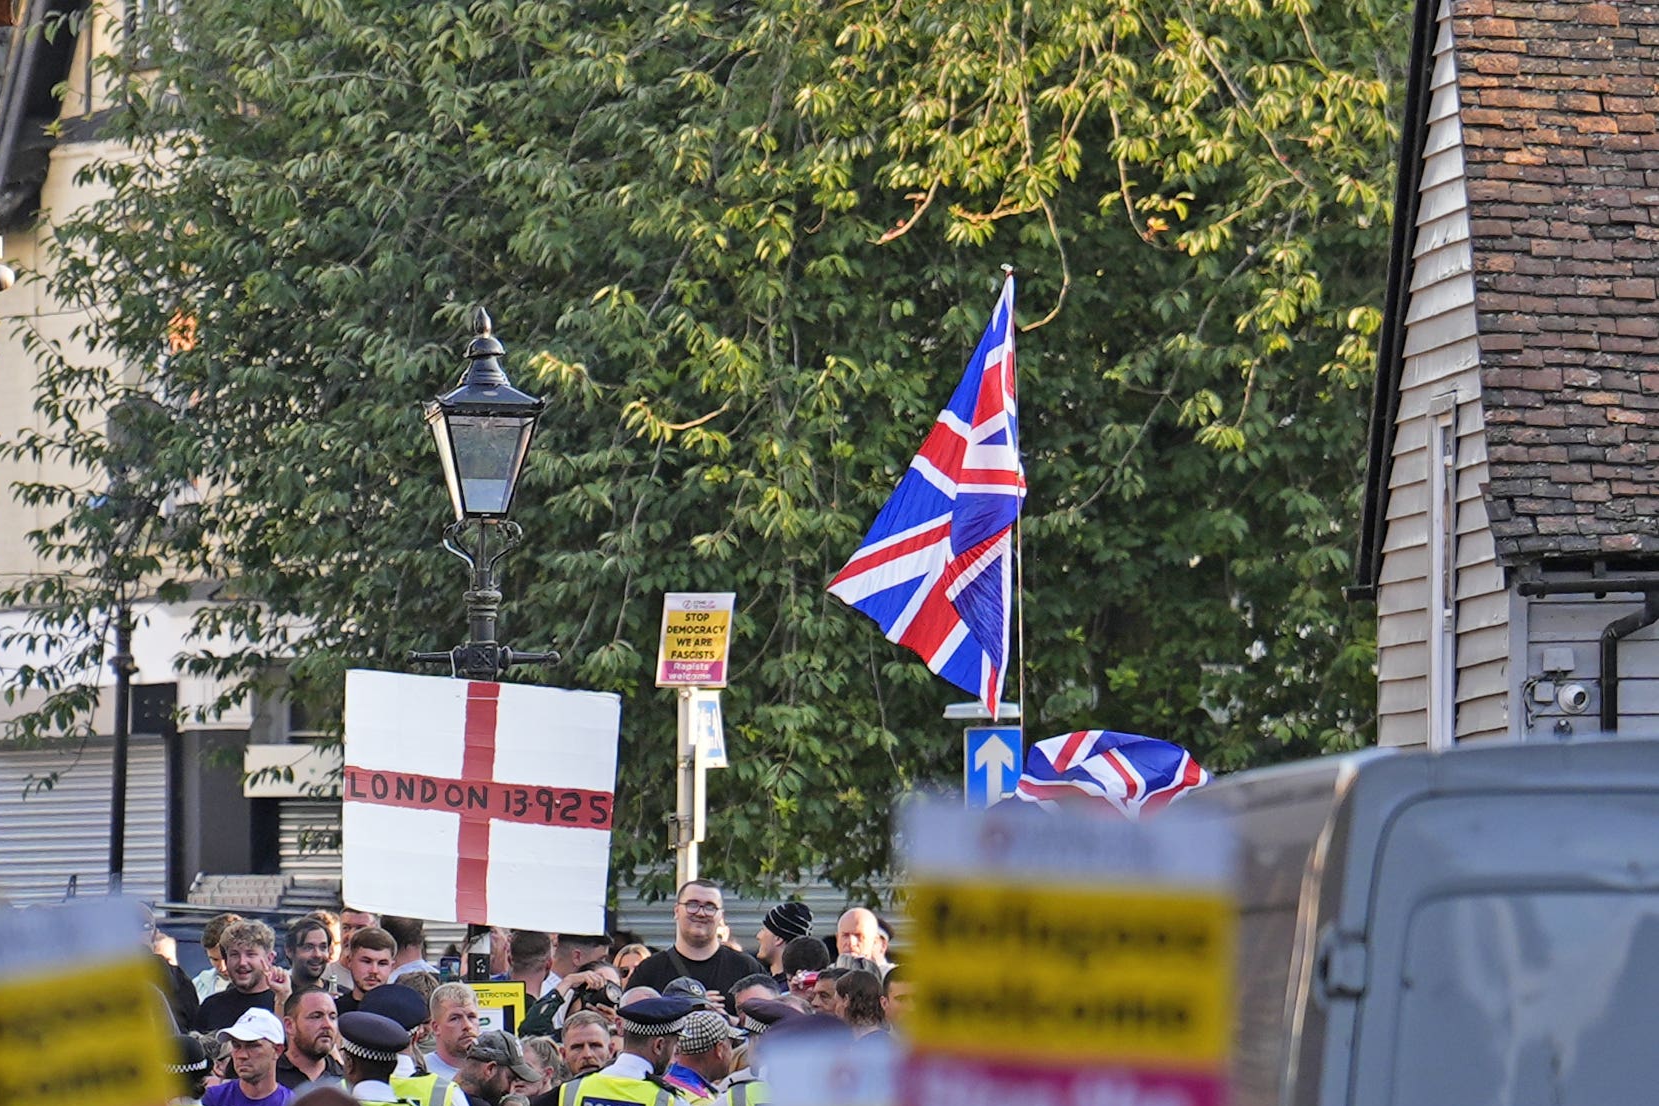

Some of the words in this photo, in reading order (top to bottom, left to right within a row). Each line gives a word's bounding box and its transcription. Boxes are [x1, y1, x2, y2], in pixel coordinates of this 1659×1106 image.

[684, 612, 710, 622] STOP
[666, 625, 726, 634] DEMOCRACY
[676, 638, 692, 647] WE
[693, 638, 713, 647] ARE
[670, 650, 715, 660] FASCISTS
[349, 771, 489, 810] LONDON
